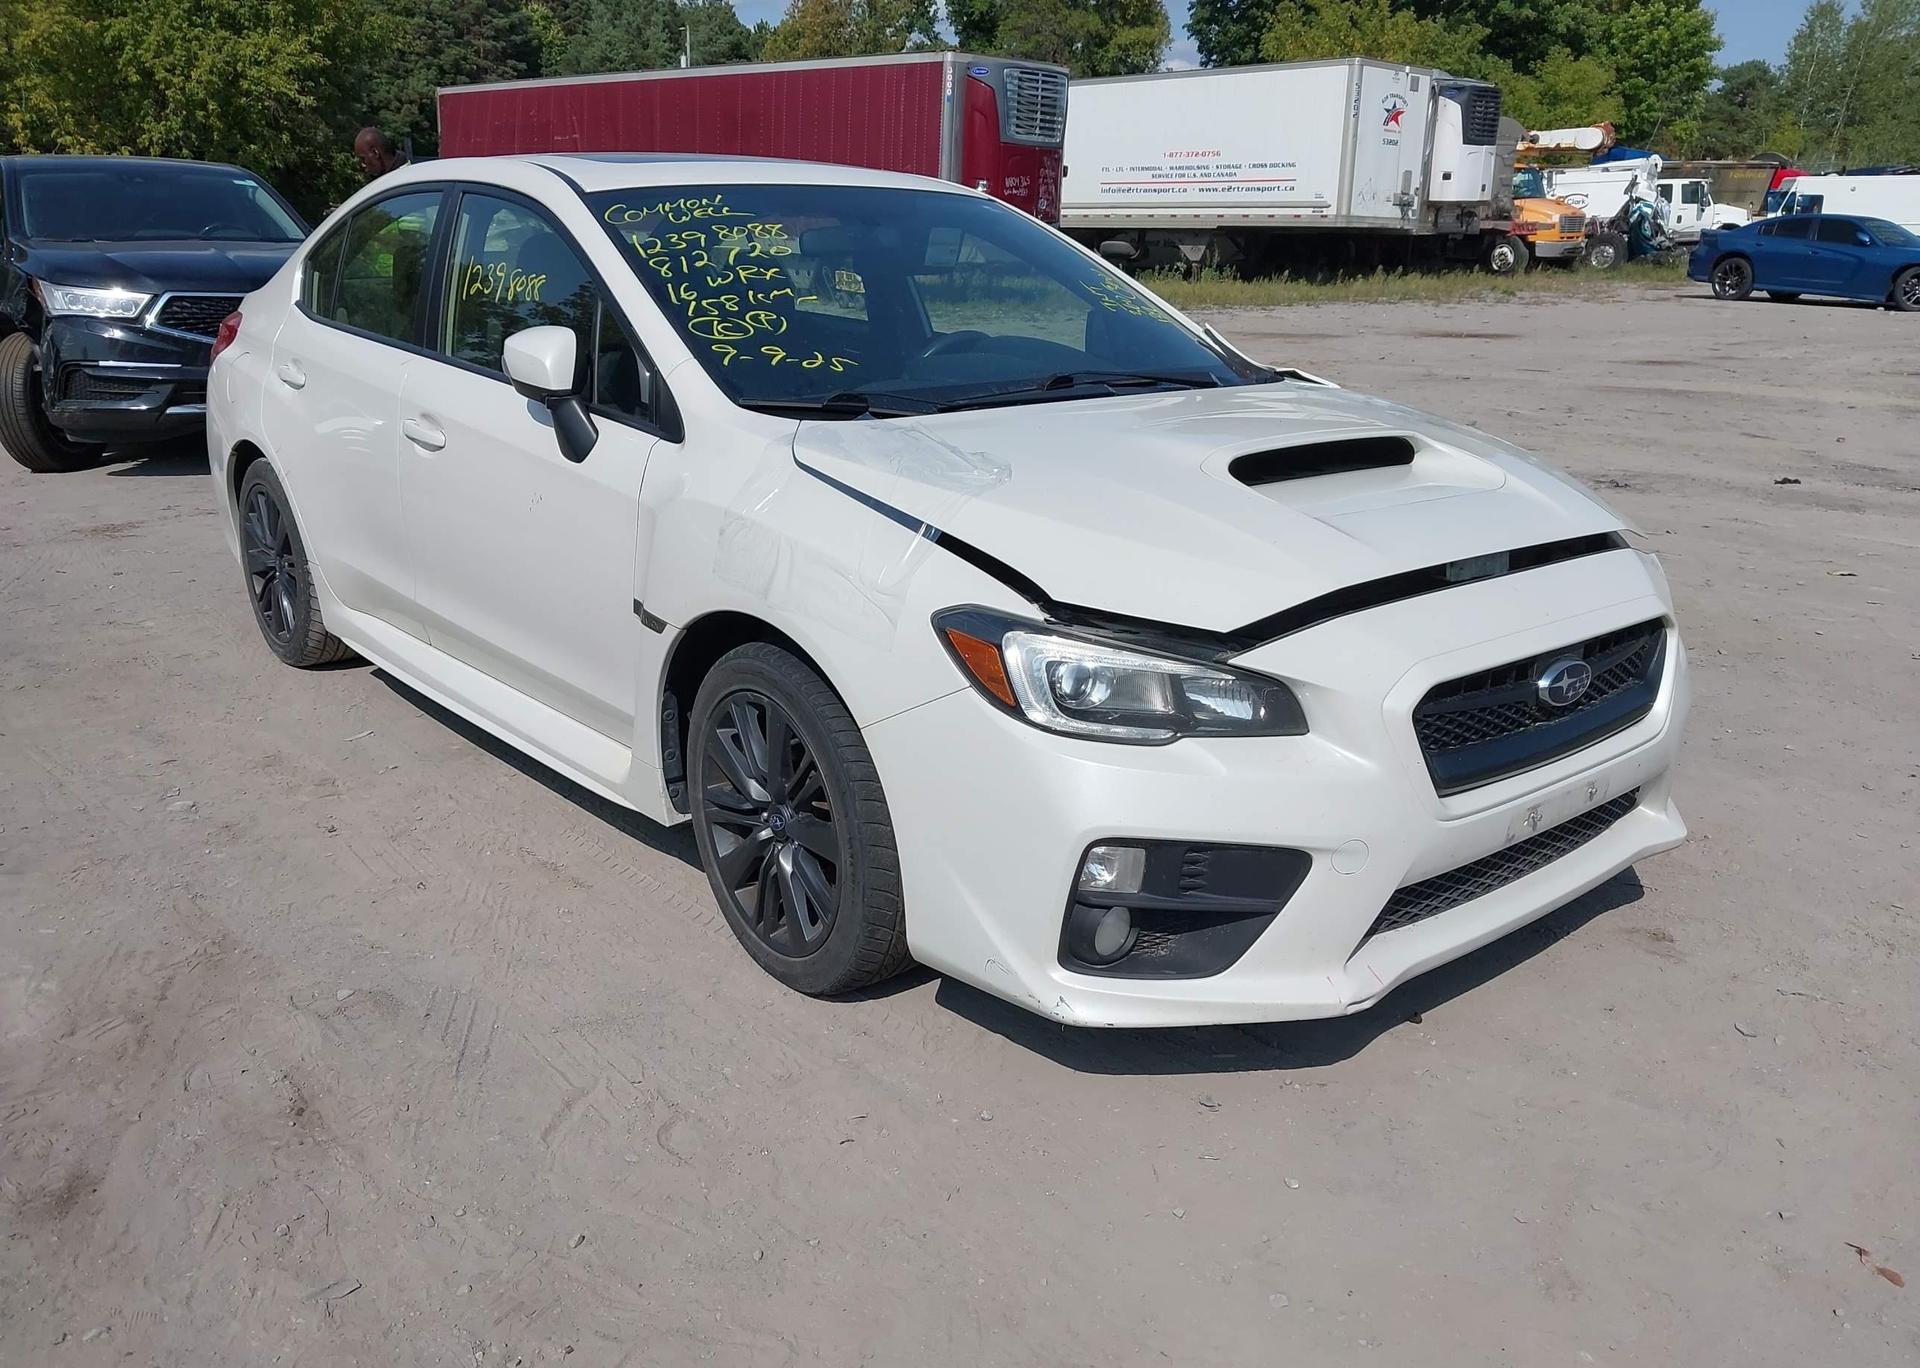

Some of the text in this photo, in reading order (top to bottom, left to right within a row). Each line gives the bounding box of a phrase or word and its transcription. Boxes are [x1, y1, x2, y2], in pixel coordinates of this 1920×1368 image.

[1198, 185, 1295, 193] www.e2rtransport.ca
[631, 223, 788, 259] 1239 8088
[649, 242, 792, 277] 812 720
[463, 256, 546, 302] 12398088
[667, 265, 787, 305] 16 WRX
[688, 295, 740, 316] 158
